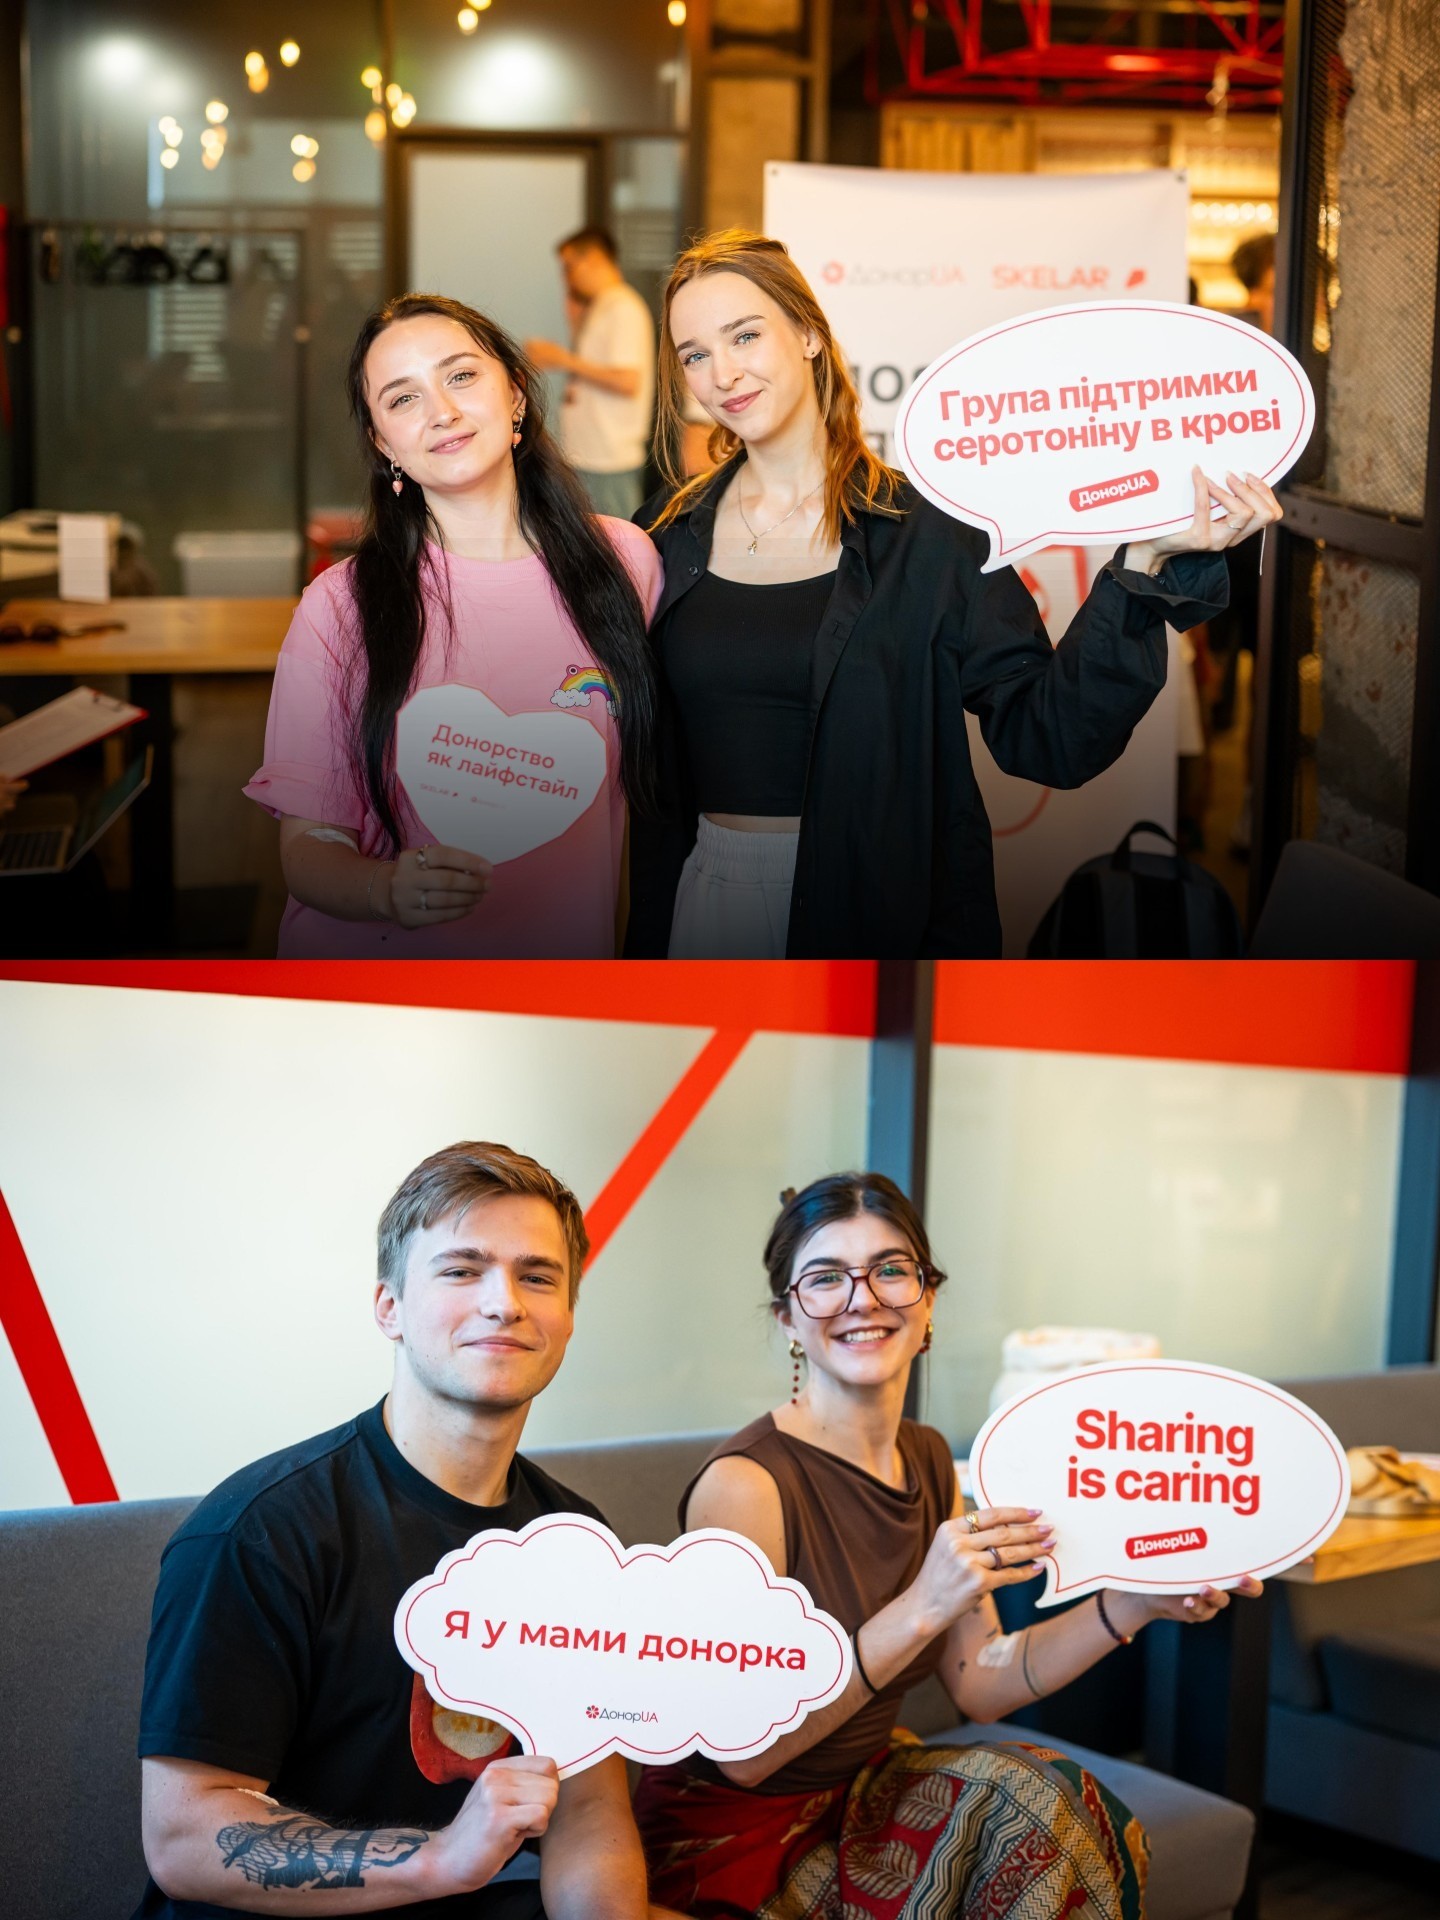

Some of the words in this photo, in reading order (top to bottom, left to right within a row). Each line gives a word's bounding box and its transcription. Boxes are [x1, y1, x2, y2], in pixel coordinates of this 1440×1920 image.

[992, 264, 1110, 290] SKELAR
[940, 389, 1050, 426] Група
[1059, 369, 1257, 413] підтримки
[934, 416, 1141, 465] серотоніну
[1151, 419, 1172, 441] в
[1182, 399, 1281, 444] крові
[1079, 475, 1151, 507] ДонорUA
[431, 724, 555, 769] Донорство
[427, 751, 452, 768] як
[457, 759, 578, 800] лайфстайл
[1076, 1409, 1254, 1467] Sharing
[1068, 1456, 1106, 1499] is
[1115, 1461, 1260, 1516] caring
[1133, 1532, 1200, 1556] ДонорUA
[445, 1610, 470, 1639] Я
[482, 1620, 507, 1649] у
[519, 1622, 627, 1654] мами
[638, 1634, 806, 1672] донорка
[599, 1707, 659, 1724] ДонорUA
